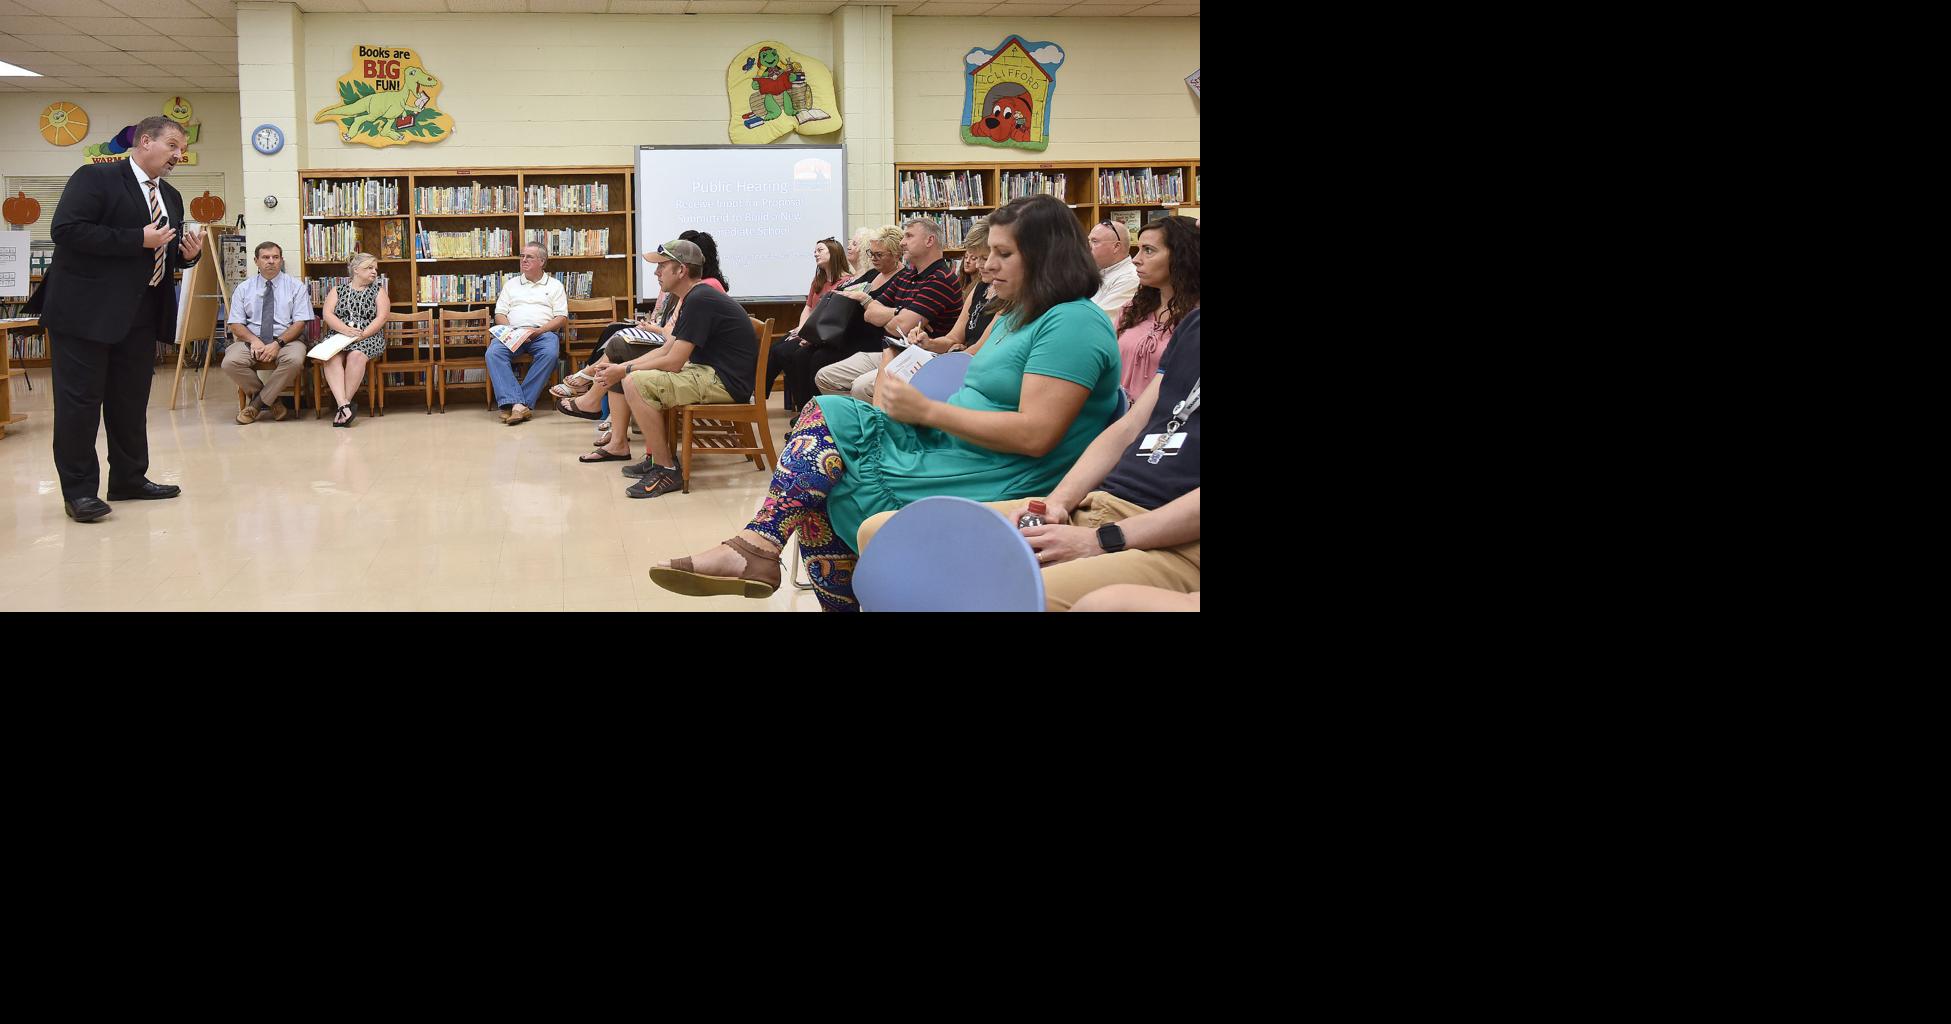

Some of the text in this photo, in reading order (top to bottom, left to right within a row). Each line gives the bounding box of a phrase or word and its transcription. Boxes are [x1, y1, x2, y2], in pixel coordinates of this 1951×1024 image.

[359, 46, 411, 60] Books are
[363, 60, 401, 79] BIG
[375, 80, 400, 91] FUN!
[986, 68, 1039, 89] CLIFFORD
[692, 181, 790, 194] Public Hearing
